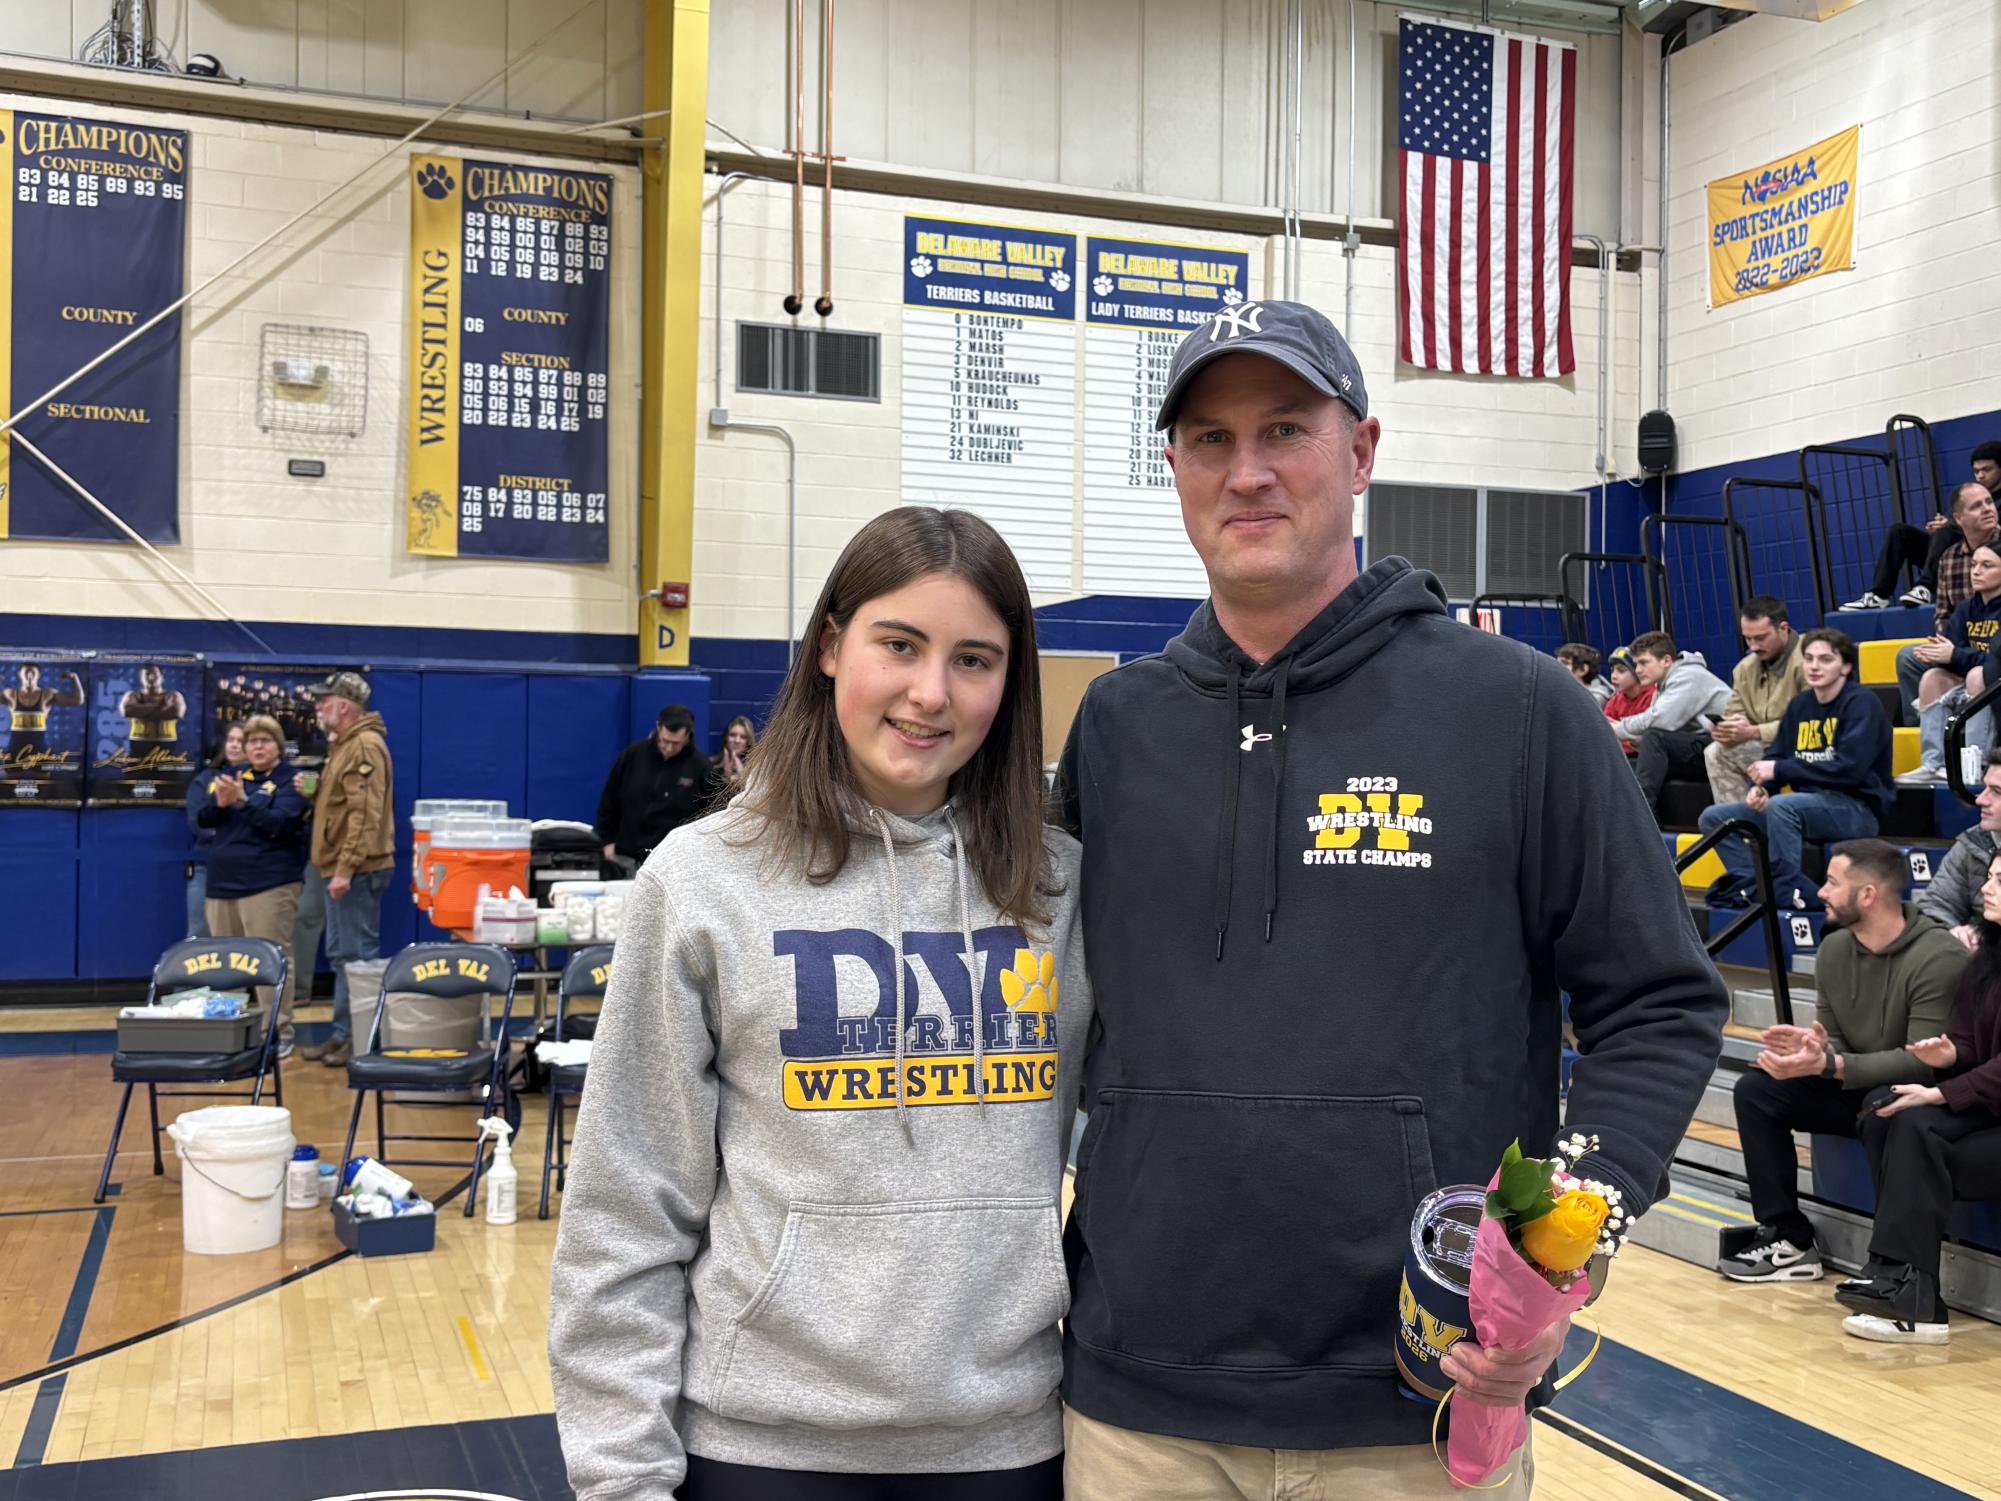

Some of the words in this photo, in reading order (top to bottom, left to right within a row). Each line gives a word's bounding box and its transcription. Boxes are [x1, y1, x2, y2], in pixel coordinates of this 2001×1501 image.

[19, 119, 183, 173] CHAMPIONS
[39, 155, 164, 181] CONFERENCE
[19, 168, 41, 184] 83
[48, 171, 70, 187] 84
[77, 174, 99, 190] 85
[106, 177, 127, 193] 89
[134, 180, 155, 197] 93
[162, 183, 183, 200] 95
[466, 167, 609, 216] CHAMPIONS
[18, 186, 38, 202] 21
[47, 189, 70, 205] 22
[76, 191, 98, 207] 25
[483, 200, 592, 223] CONFERENCE
[1713, 180, 1849, 247] SPORTSMANSHIP
[466, 212, 485, 227] 83
[491, 215, 510, 229] 84
[516, 217, 535, 232] 85
[541, 220, 560, 234] 87
[565, 222, 584, 236] 88
[590, 225, 609, 239] 93
[466, 228, 485, 242] 94
[491, 230, 510, 245] 99
[516, 233, 535, 247] 00
[540, 235, 556, 250] 01
[565, 238, 584, 252] 02
[589, 240, 608, 254] 03
[916, 231, 1002, 262] DELAWARE
[1005, 241, 1066, 268] VALLEY
[1746, 223, 1808, 264] AWARD
[466, 244, 484, 258] 04
[490, 246, 509, 260] 05
[515, 249, 534, 263] 06
[540, 251, 559, 265] 08
[565, 253, 583, 268] 09
[589, 256, 603, 270] 10
[465, 259, 478, 274] 11
[490, 262, 506, 276] 12
[515, 264, 531, 278] 19
[540, 267, 559, 281] 23
[564, 269, 583, 283] 24
[1098, 251, 1179, 280] DELAWARE
[1181, 260, 1238, 285] VALLEY
[926, 284, 980, 304] TERRIERS
[984, 290, 1055, 311] BASKETBALL
[62, 306, 138, 326] COUNTY
[503, 307, 569, 325] COUNTY
[955, 313, 960, 324] 0
[969, 314, 1023, 330] BONTEMPO
[1091, 302, 1121, 317] LADY
[1123, 304, 1174, 322] TERRIERS
[1177, 309, 1216, 325] BASKE
[464, 317, 484, 333] 06
[957, 326, 960, 338] 1
[969, 327, 1003, 342] MATOS
[419, 248, 449, 447] WRESTLING
[955, 340, 961, 352] 2
[969, 341, 1004, 355] MARSH
[1139, 331, 1142, 341] 1
[1147, 331, 1178, 344] BURKE
[1136, 344, 1141, 354] 2
[501, 352, 571, 369] SECTION
[954, 354, 960, 365] 3
[1136, 357, 1141, 367] 3
[1147, 358, 1171, 369] MOS
[464, 363, 483, 377] 83
[489, 365, 508, 379] 84
[514, 367, 533, 381] 85
[538, 369, 558, 384] 87
[563, 371, 582, 386] 88
[588, 374, 607, 388] 89
[954, 367, 960, 378] 5
[1136, 371, 1141, 381] 4
[1147, 371, 1166, 382] WAL
[464, 378, 483, 393] 90
[488, 381, 507, 395] 93
[513, 383, 532, 397] 94
[538, 385, 557, 399] 99
[563, 387, 578, 402] 01
[587, 389, 606, 404] 02
[950, 381, 960, 392] 10
[1136, 383, 1141, 394] 5
[463, 394, 482, 409] 05
[488, 396, 507, 411] 06
[513, 398, 529, 413] 15
[539, 401, 555, 415] 16
[562, 403, 577, 417] 17
[587, 405, 603, 419] 19
[952, 394, 961, 406] 11
[967, 395, 1018, 410] REYNOLDS
[1132, 396, 1141, 407] 10
[47, 402, 151, 423] SECTIONAL
[463, 410, 482, 424] 20
[488, 412, 507, 426] 22
[512, 414, 531, 428] 23
[537, 416, 556, 430] 24
[561, 418, 580, 432] 25
[951, 408, 961, 419] 13
[1134, 409, 1141, 420] 11
[950, 422, 961, 433] 21
[969, 423, 1020, 437] KAMINSKI
[1131, 422, 1141, 433] 12
[950, 435, 963, 447] 24
[1131, 435, 1141, 446] 15
[949, 449, 963, 460] 32
[1129, 449, 1141, 460] 20
[1130, 462, 1141, 473] 21
[1147, 462, 1164, 474] FOX
[499, 474, 572, 491] DISTRICT
[1128, 475, 1141, 486] 25
[1146, 476, 1176, 487] HARV
[462, 486, 481, 500] 75
[488, 488, 507, 502] 84
[513, 489, 532, 503] 93
[537, 491, 556, 505] 05
[562, 492, 581, 507] 06
[587, 494, 606, 508] 07
[462, 502, 481, 516] 08
[489, 504, 505, 518] 17
[513, 505, 532, 519] 20
[537, 507, 556, 521] 22
[562, 508, 581, 522] 23
[587, 510, 606, 524] 24
[462, 518, 481, 532] 25
[658, 624, 675, 649] D
[1346, 776, 1398, 792] 2023
[1306, 811, 1433, 834] WRESTLING
[1302, 849, 1357, 865] STATE
[1361, 850, 1432, 869] CHAMPS
[184, 952, 222, 976] DEL
[229, 952, 260, 976] VAL
[412, 958, 450, 982] DEL
[458, 958, 490, 983] VAL
[794, 1059, 1057, 1102] WRESTLING
